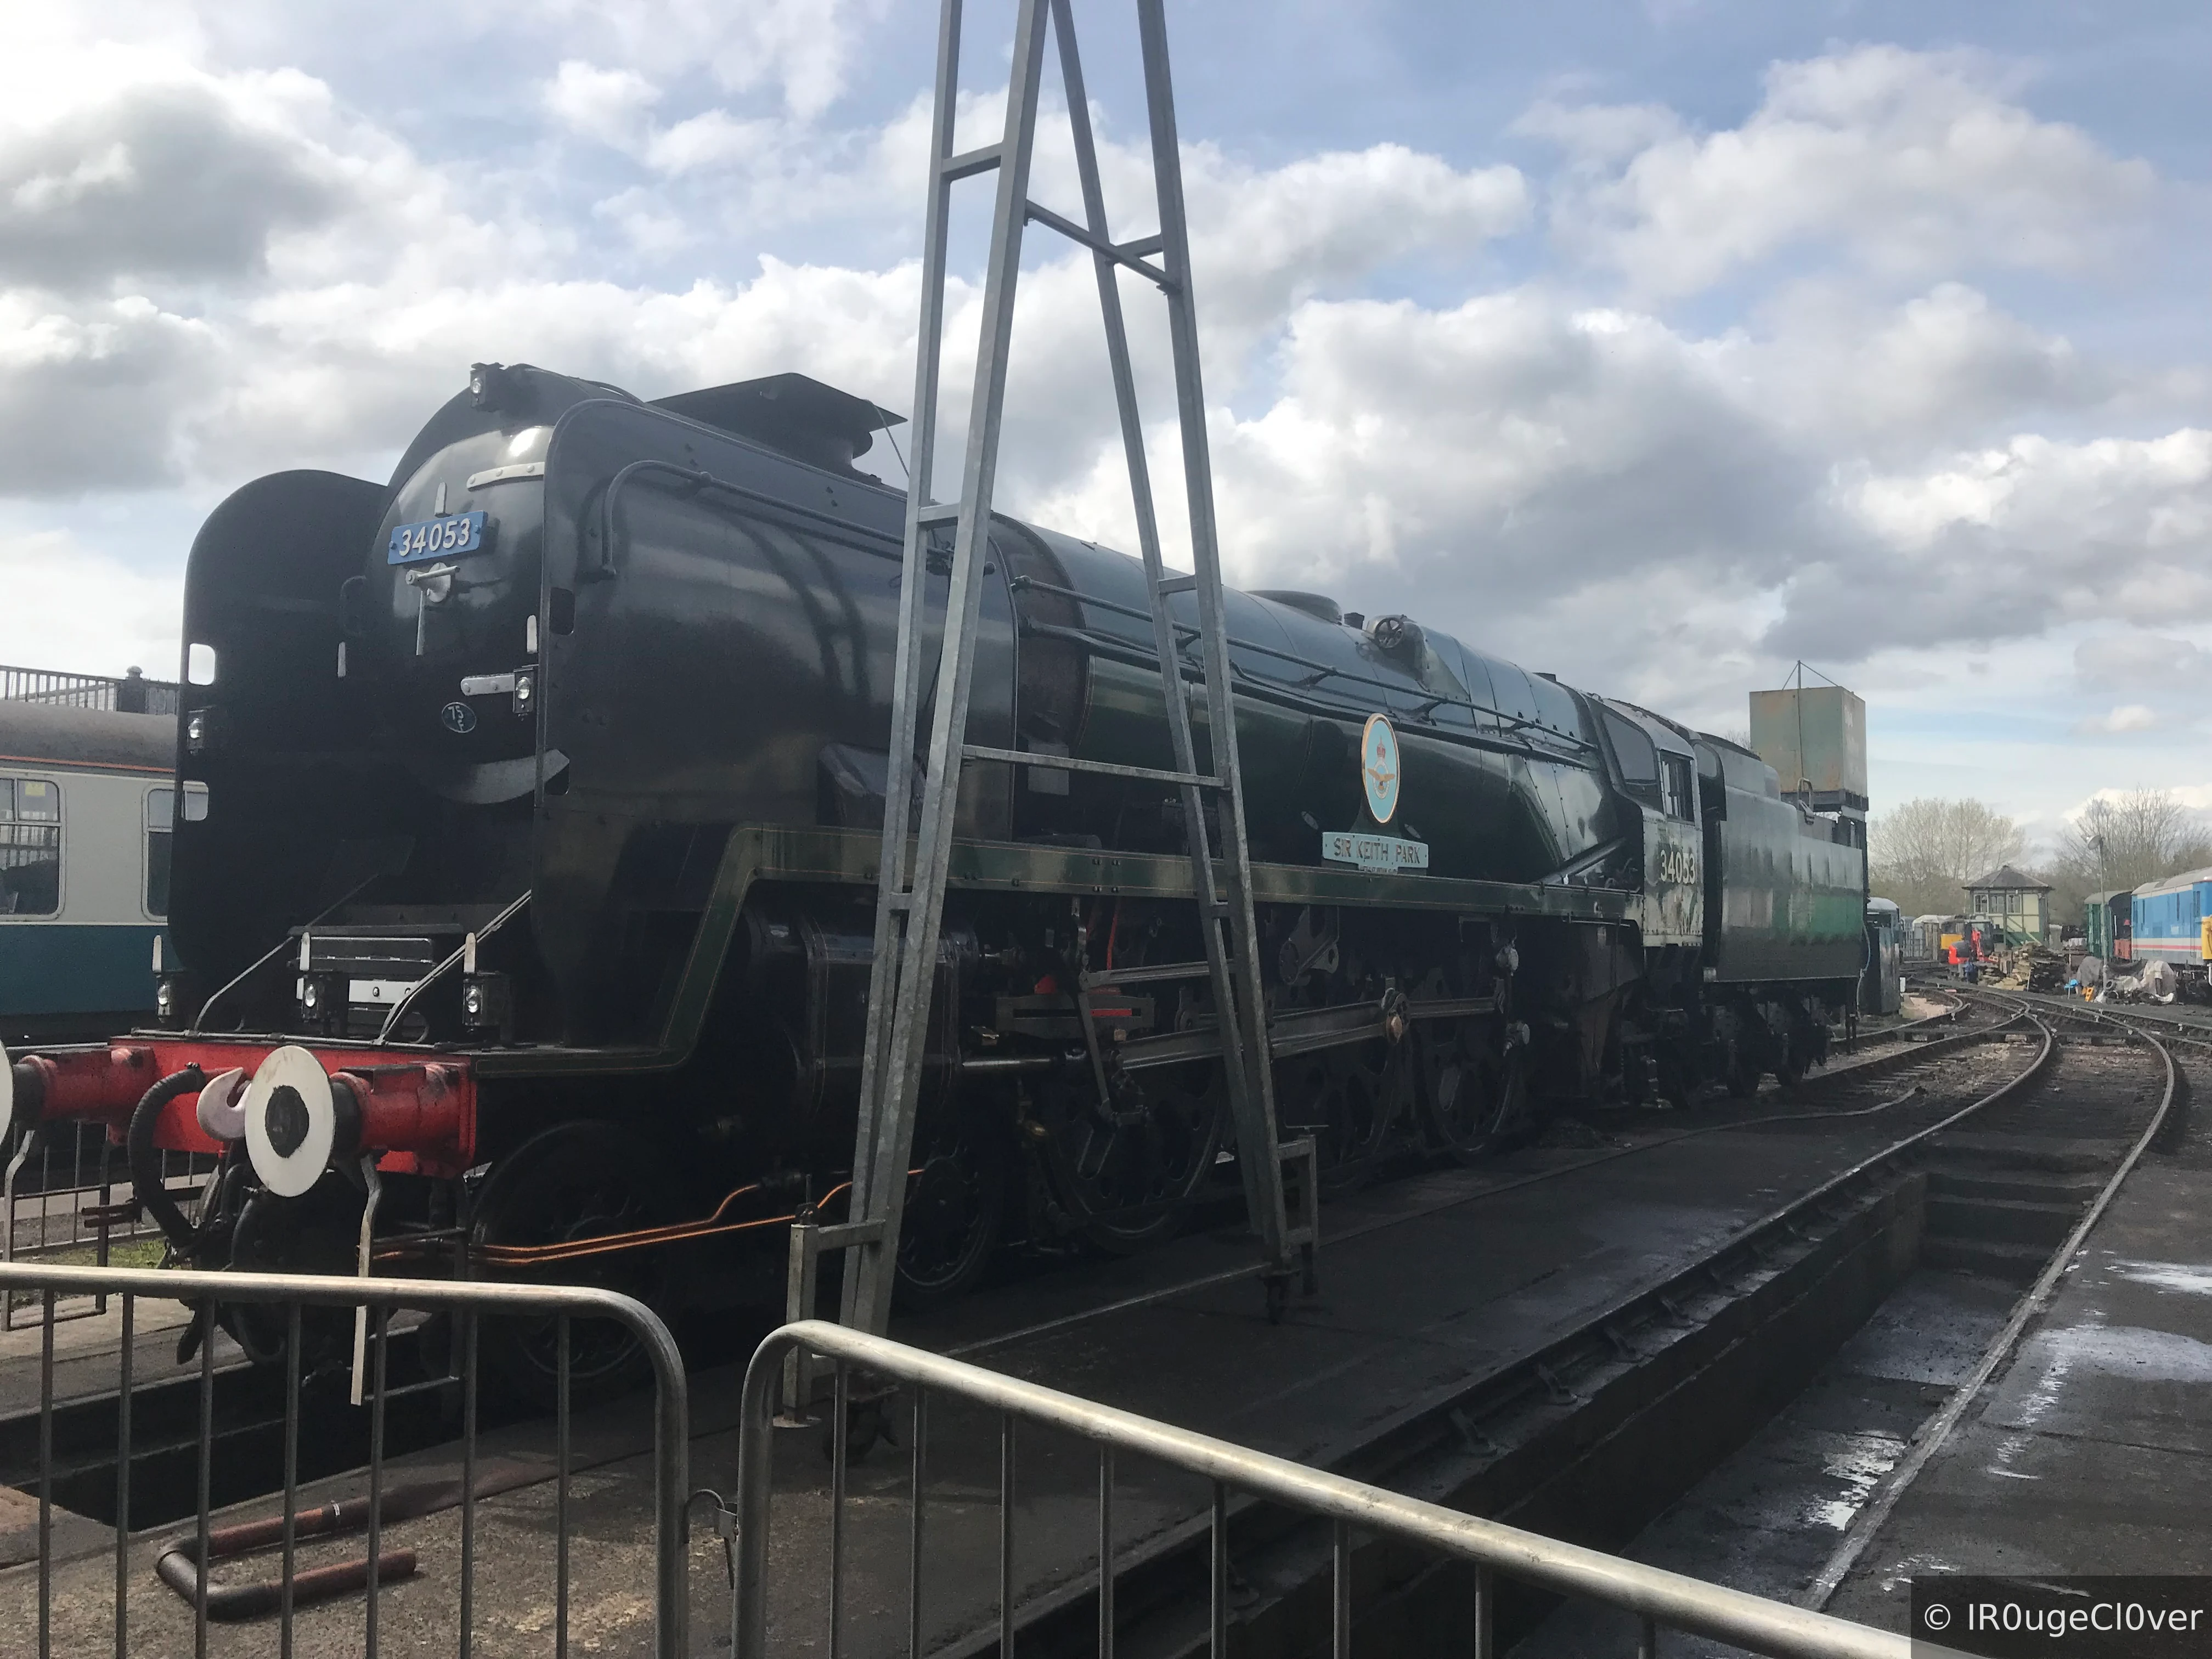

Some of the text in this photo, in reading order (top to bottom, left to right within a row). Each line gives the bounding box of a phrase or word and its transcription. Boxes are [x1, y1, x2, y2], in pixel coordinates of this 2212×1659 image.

[398, 517, 471, 557] 34053
[447, 706, 464, 720] 75
[1333, 837, 1420, 864] SIR KEITH PARK
[1660, 849, 1695, 884] 34053
